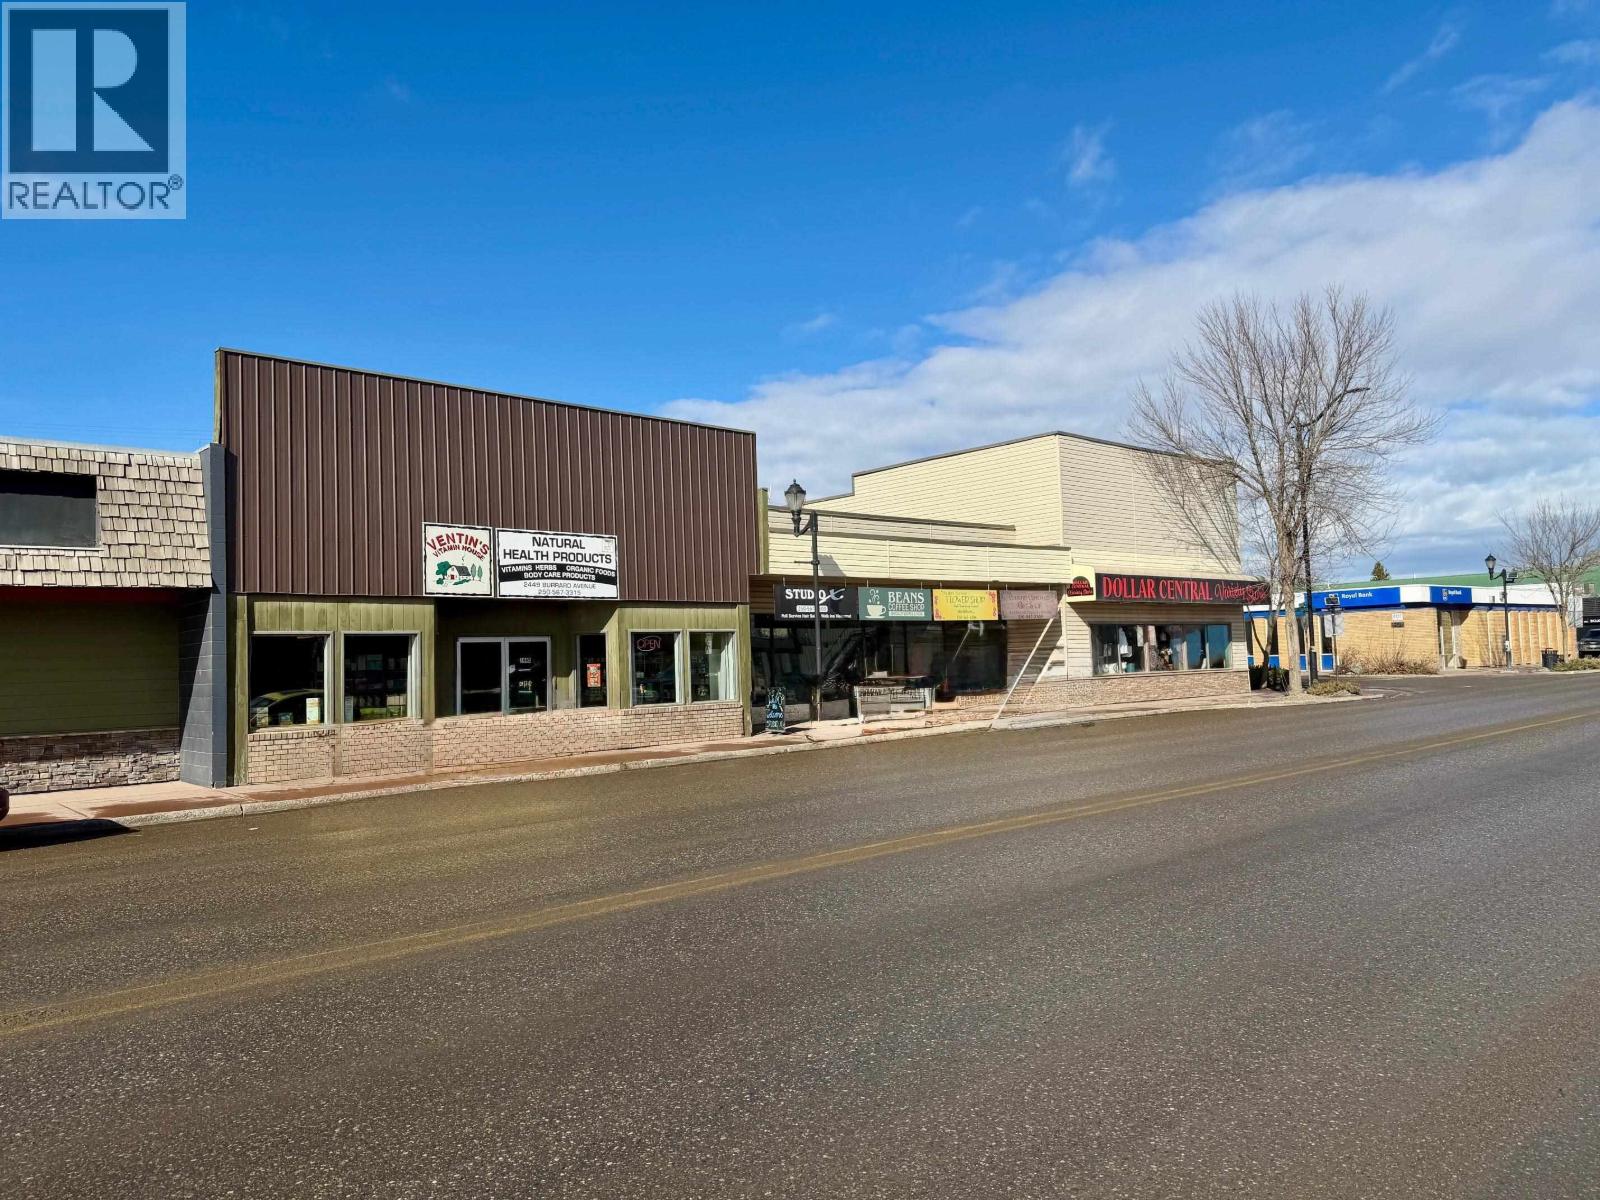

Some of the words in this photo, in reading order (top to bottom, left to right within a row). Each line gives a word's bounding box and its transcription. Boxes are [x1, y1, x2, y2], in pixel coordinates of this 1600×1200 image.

[427, 532, 490, 555] VENTIN'S
[532, 536, 586, 549] NATURAL
[433, 544, 461, 558] VITAMIN
[462, 545, 486, 561] HOUSE
[503, 549, 549, 561] HEALTH
[553, 552, 612, 564] PRODUCTS
[501, 565, 533, 573] VITAMINS
[566, 565, 594, 574] ORGANIC
[595, 569, 616, 577] FOODS
[562, 572, 596, 580] PRODUCTS
[573, 582, 597, 590] AVENUE
[1102, 576, 1157, 599] DOLLAR
[1159, 579, 1213, 600] CENTRAL
[785, 588, 827, 600] STUDO
[887, 591, 925, 604] BEANS
[888, 603, 910, 611] COFFEE
[909, 603, 925, 611] SHOP
[637, 639, 661, 649] OPEN
